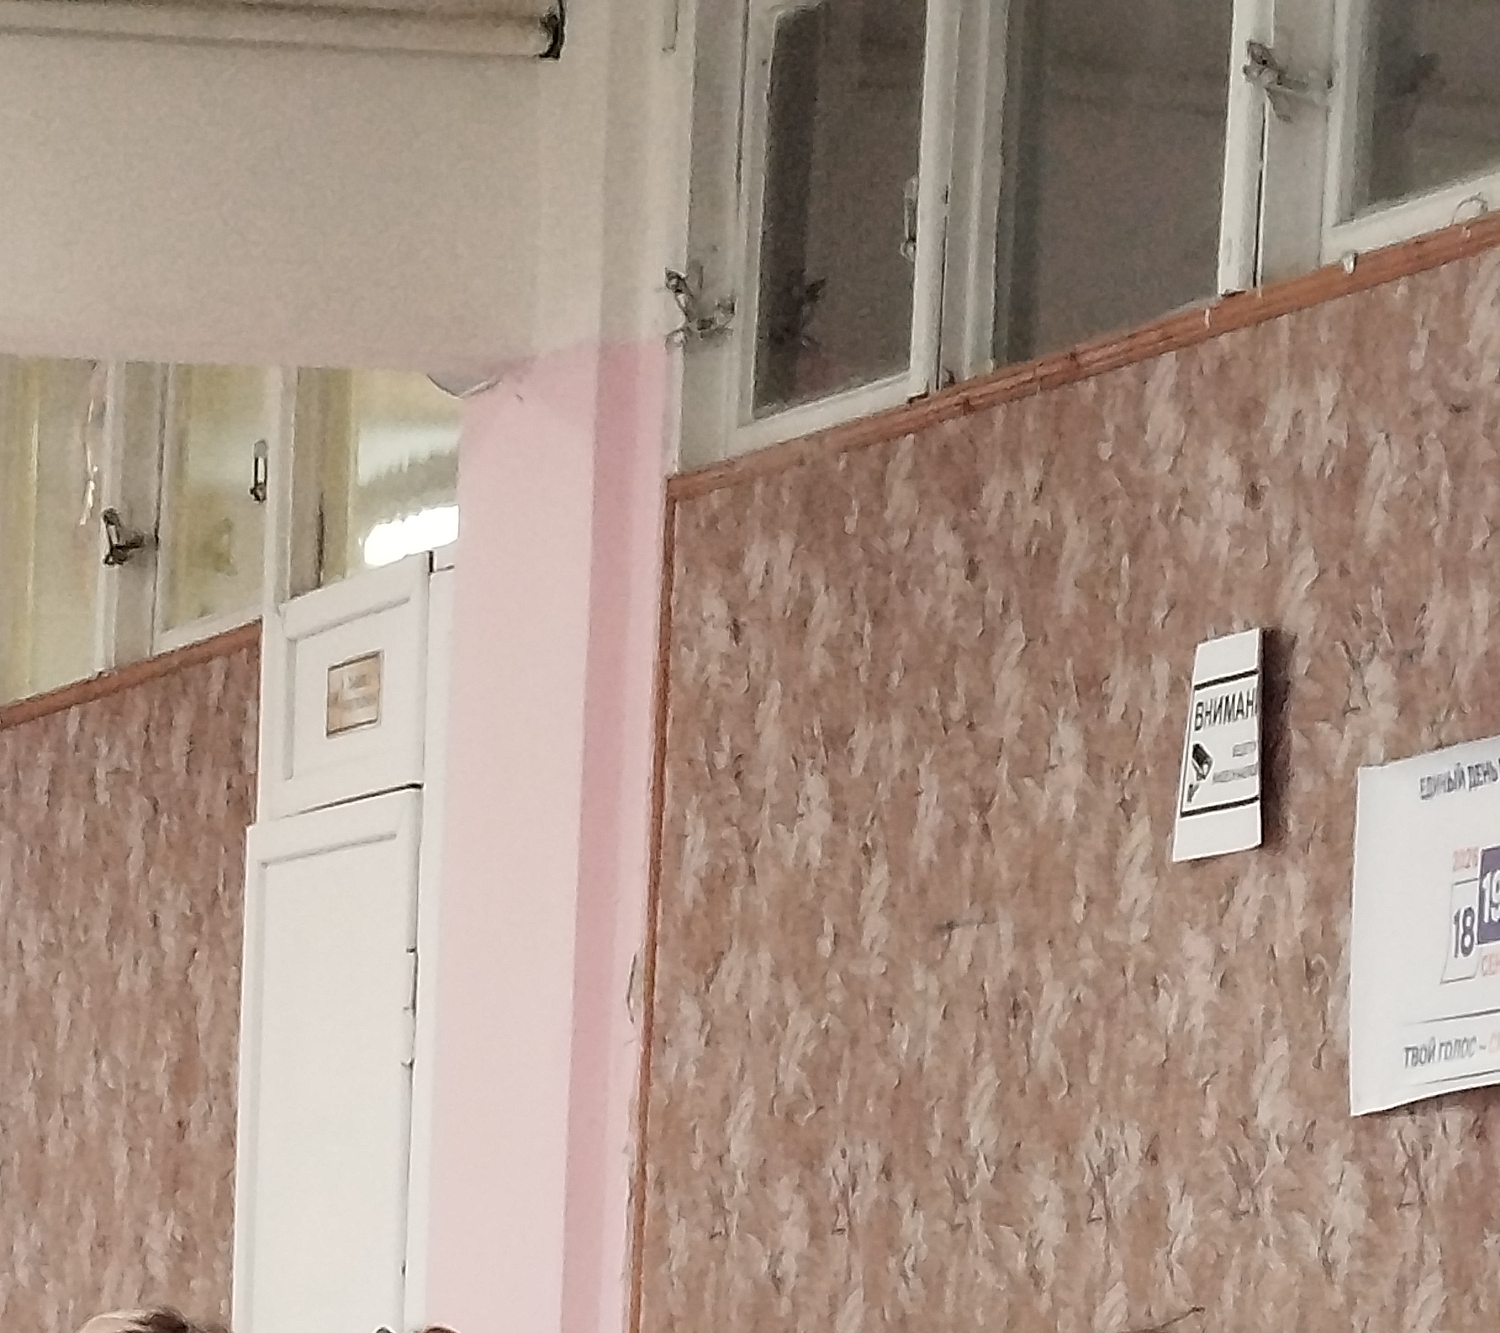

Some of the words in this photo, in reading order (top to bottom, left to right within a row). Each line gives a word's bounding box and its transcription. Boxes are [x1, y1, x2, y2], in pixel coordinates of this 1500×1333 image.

[1453, 905, 1475, 958] 18
[1404, 1035, 1436, 1068] ТВОЙ
[1439, 1035, 1477, 1062] ГОЛОС
